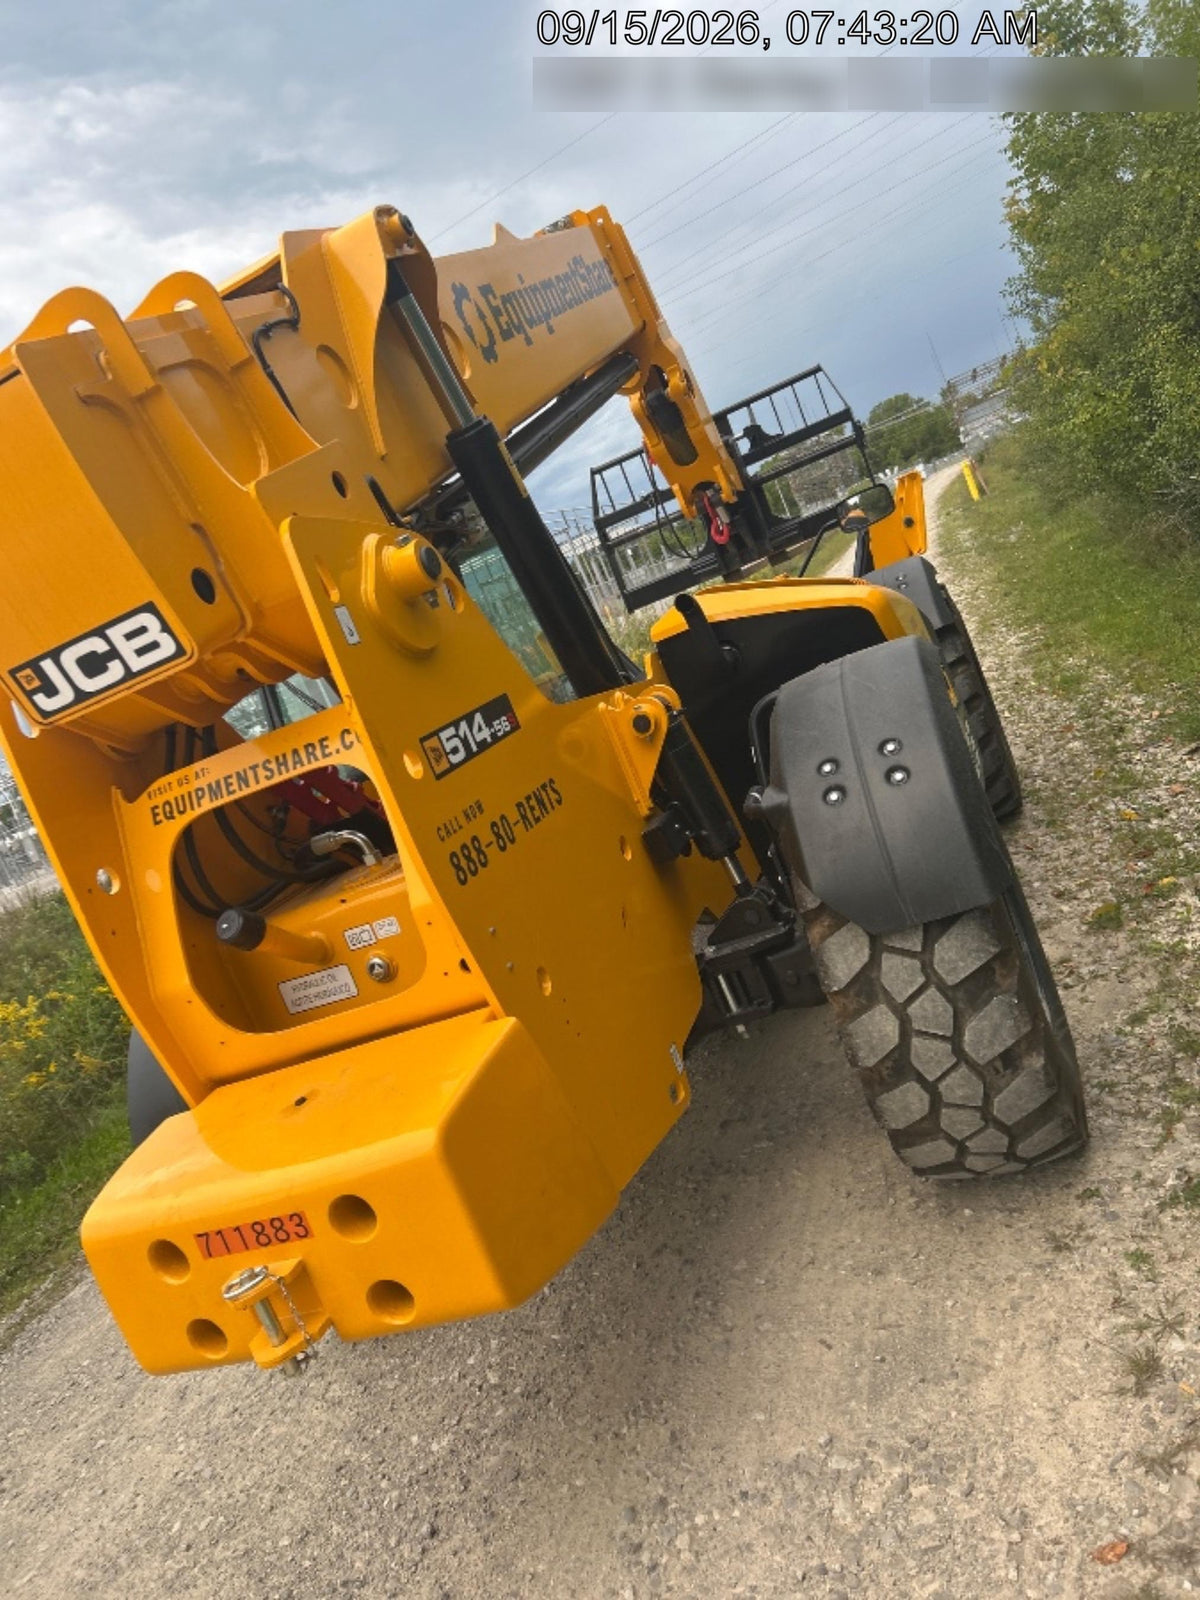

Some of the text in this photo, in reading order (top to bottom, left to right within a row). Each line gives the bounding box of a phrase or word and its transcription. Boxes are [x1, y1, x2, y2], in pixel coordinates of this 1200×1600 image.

[32, 612, 177, 712] JCB
[147, 781, 173, 800] VISIT
[177, 774, 190, 788] US
[437, 799, 484, 842] CALL NOW
[449, 777, 563, 886] 888-80-RENTS
[196, 1212, 309, 1258] 711883
